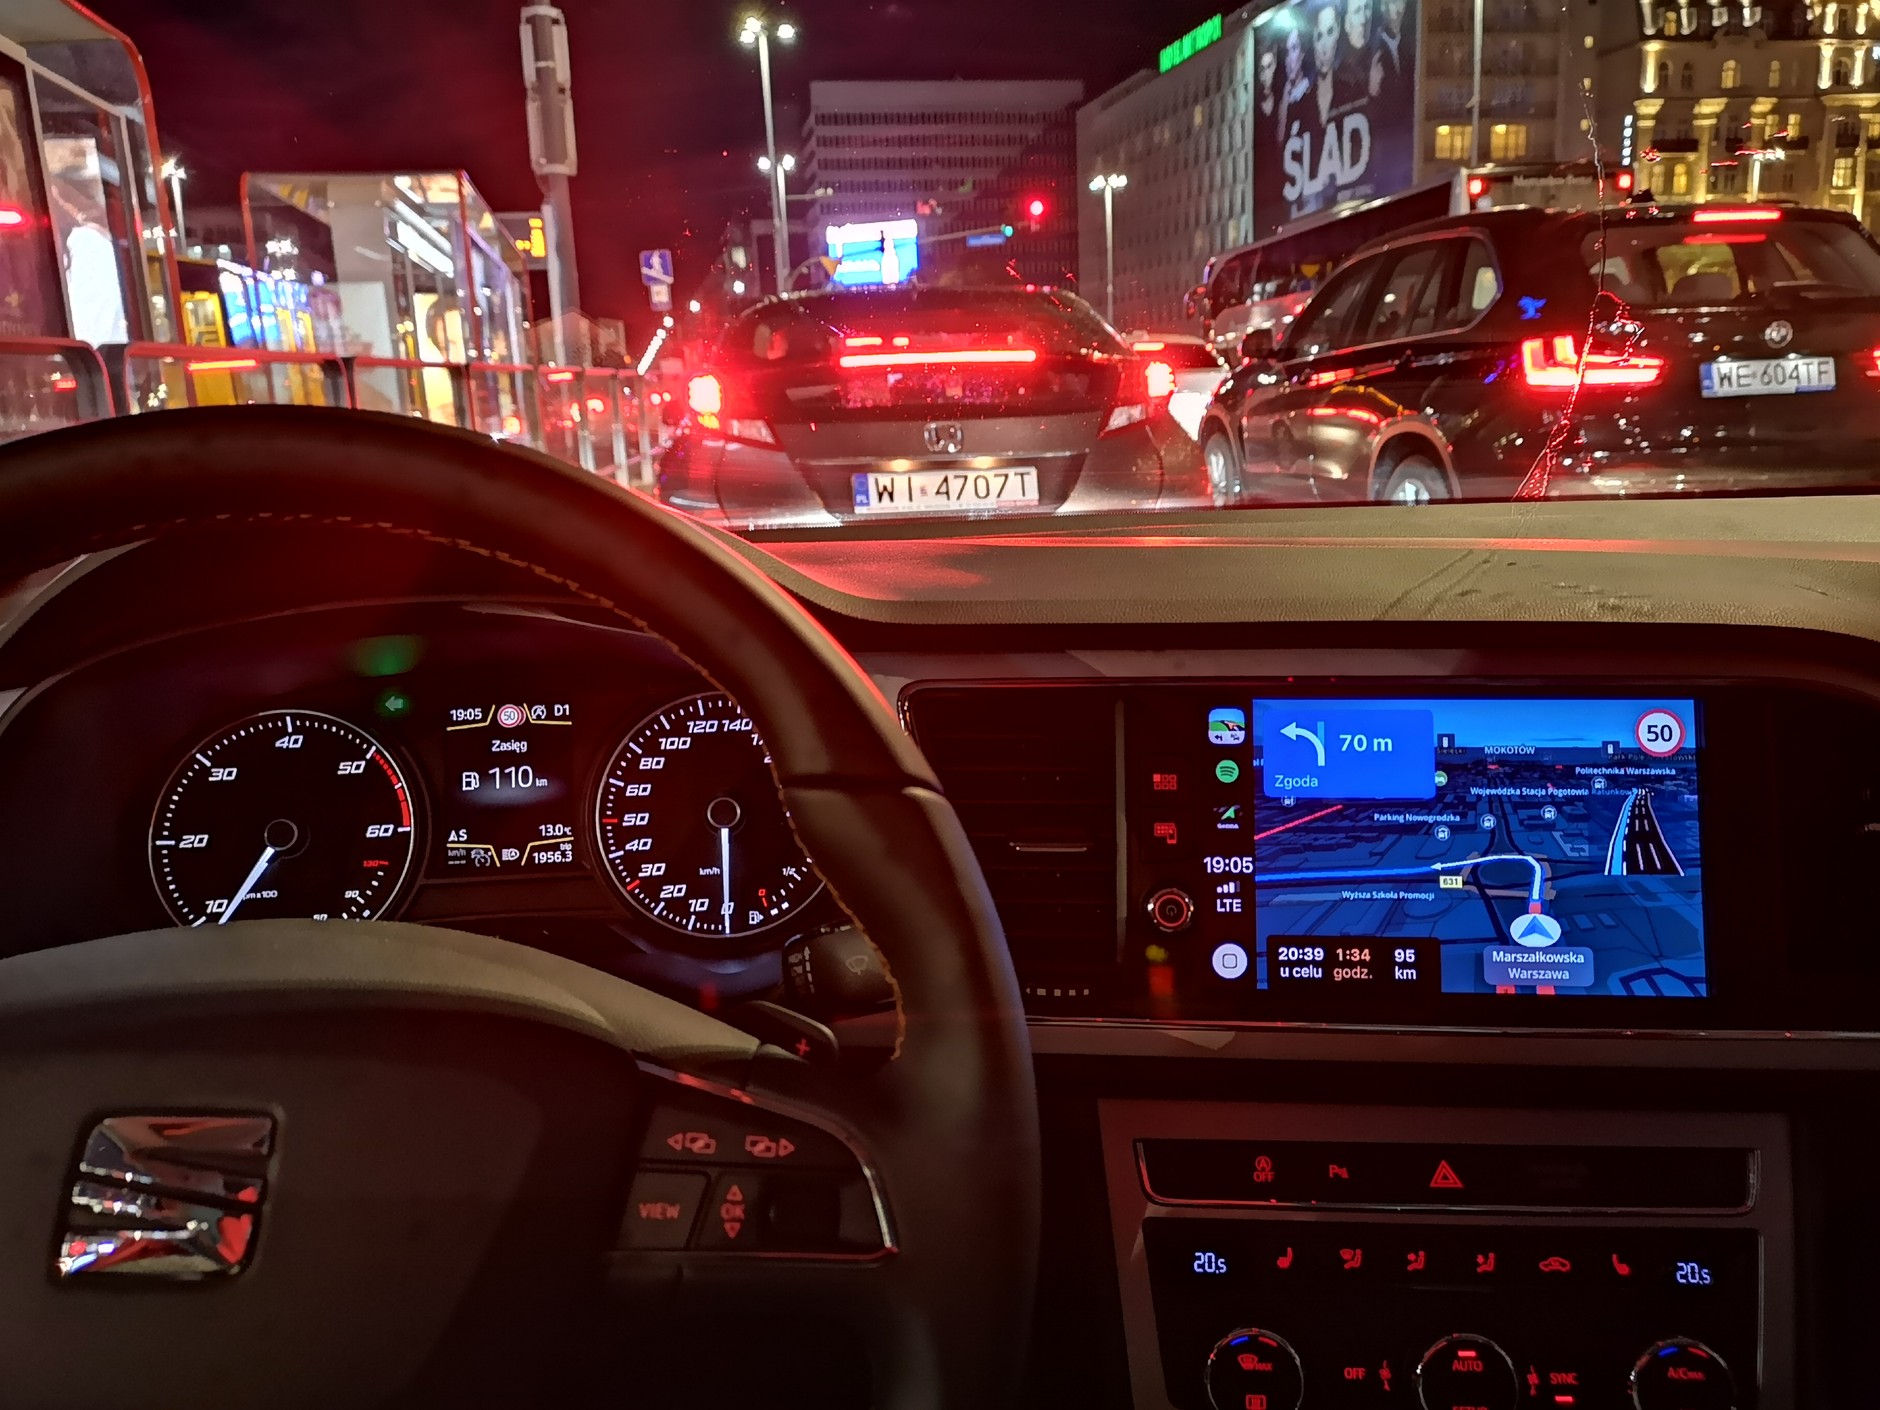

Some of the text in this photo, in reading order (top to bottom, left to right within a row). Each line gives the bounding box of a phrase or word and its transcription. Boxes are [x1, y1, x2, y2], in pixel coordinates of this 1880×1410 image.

[1283, 113, 1371, 201] ŚLAD
[1717, 364, 1751, 389] WE
[1760, 361, 1830, 387] 604TF
[875, 471, 1031, 504] WI 4707T
[450, 708, 482, 721] 19:05
[503, 710, 516, 721] 50
[554, 704, 570, 717] D1
[687, 719, 718, 733] 120
[722, 718, 753, 732] 140
[1646, 723, 1674, 743] 50
[275, 735, 304, 749] 40
[491, 740, 528, 753] Zasięg
[658, 737, 691, 751] 100
[1339, 733, 1393, 752] 70 m
[1484, 744, 1536, 755] MOKOTÓW
[338, 760, 365, 774] 50
[639, 757, 665, 770] 80
[208, 767, 237, 781] 30
[488, 765, 548, 789] 110 km
[1575, 766, 1676, 776] Politechnika Warszawska
[1274, 774, 1319, 790] Zgoda
[625, 784, 652, 797] 60
[1470, 785, 1521, 796] Wojewódzka
[1522, 786, 1546, 796] Stacja
[1548, 786, 1589, 796] Pogotowia
[622, 813, 649, 827] 50
[1374, 813, 1460, 824] Parking Nowogrodzka
[366, 824, 394, 837] 60
[179, 834, 209, 849] 20
[625, 838, 653, 852] 40
[532, 851, 573, 864] 1956.3
[1203, 856, 1254, 873] 19:05
[638, 863, 666, 876] 30
[699, 867, 721, 875] km/h
[1443, 878, 1459, 886] 631
[660, 884, 687, 897] 20
[1342, 890, 1435, 901] Wyższa Szkoła Promocji
[205, 899, 229, 914] 10
[688, 898, 709, 912] 10
[1217, 899, 1242, 912] LTE
[1278, 946, 1325, 961] 20:39
[1336, 948, 1371, 962] 1:34
[1394, 949, 1416, 962] 95
[1492, 950, 1585, 963] Marszałkowska
[1280, 964, 1322, 978] u celu
[1333, 965, 1373, 981] godz.
[1394, 966, 1417, 980] km
[1508, 967, 1570, 980] Warszawa
[1253, 1171, 1274, 1182] OFF
[639, 1202, 680, 1219] VIEW
[721, 1202, 745, 1220] OK
[1193, 1252, 1228, 1274] 20.5
[1676, 1262, 1712, 1285] 20.5
[1452, 1360, 1483, 1372] AUTO
[1344, 1367, 1366, 1380] OFF
[1550, 1373, 1579, 1385] SYNC
